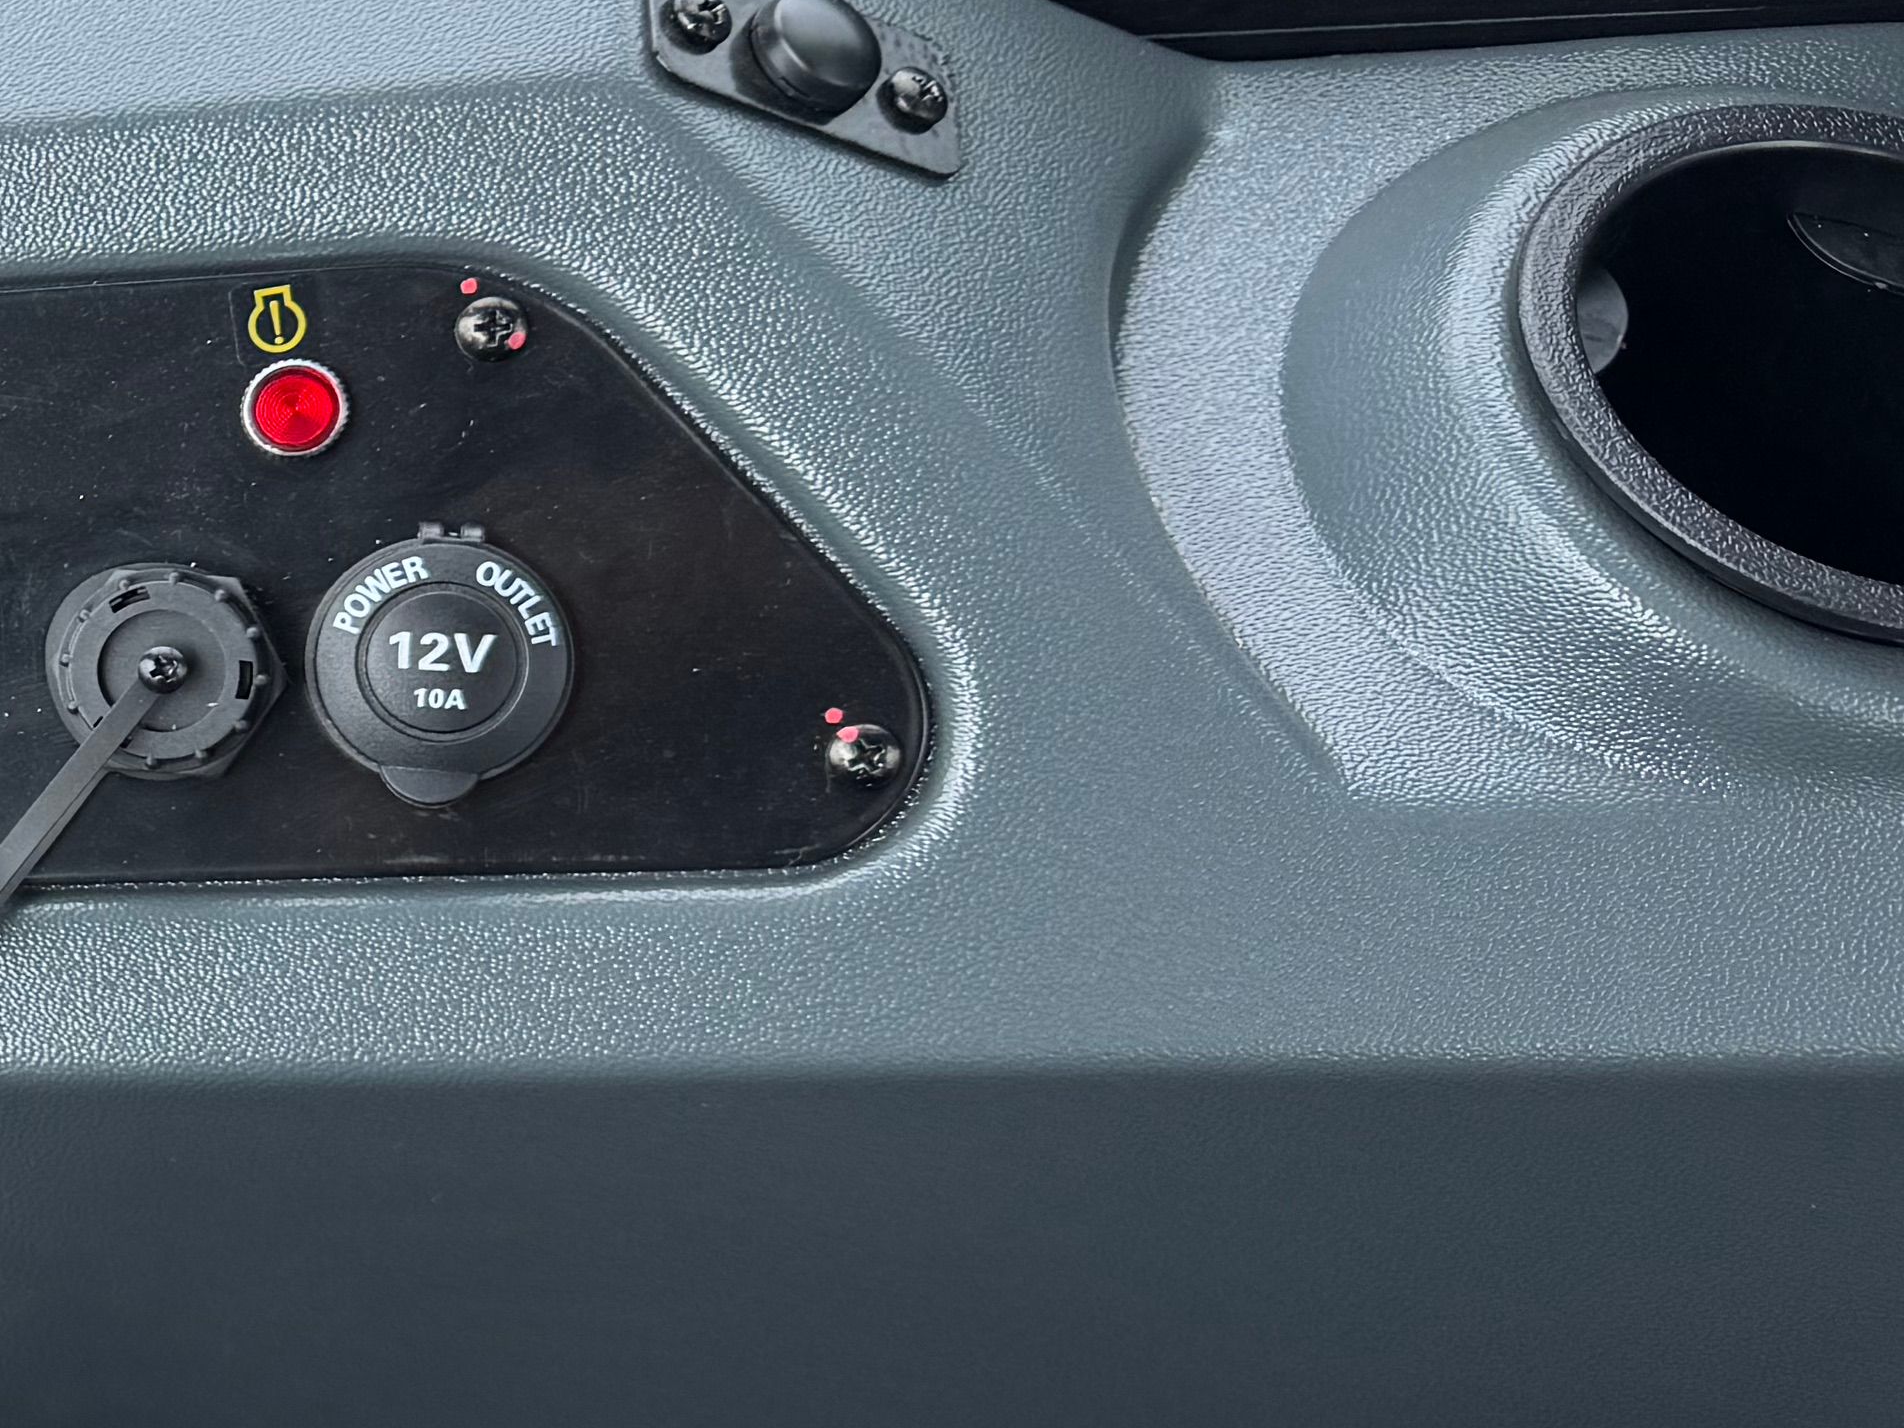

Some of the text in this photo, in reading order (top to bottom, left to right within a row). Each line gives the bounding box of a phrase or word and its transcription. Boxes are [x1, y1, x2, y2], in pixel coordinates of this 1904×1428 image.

[333, 555, 559, 648] POWER OUTLET
[388, 630, 499, 674] 12V
[413, 687, 467, 711] 10A
